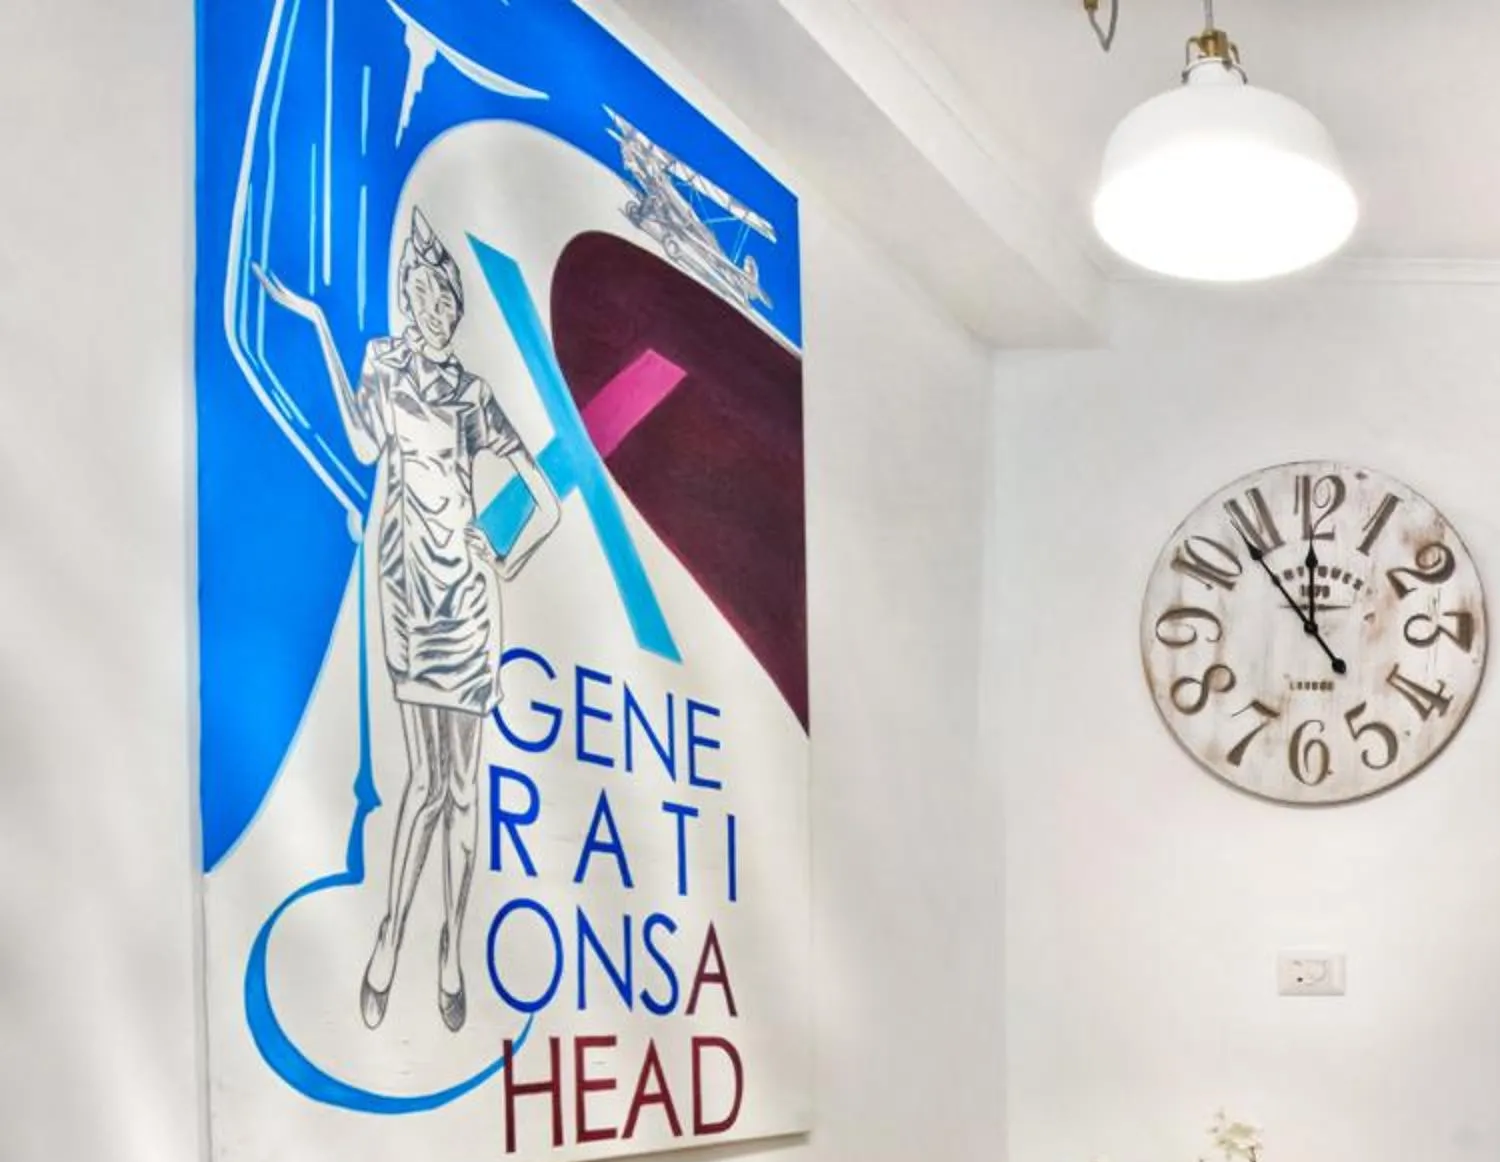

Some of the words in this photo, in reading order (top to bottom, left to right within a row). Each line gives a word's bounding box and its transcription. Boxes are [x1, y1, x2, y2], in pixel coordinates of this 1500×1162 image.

[1293, 474, 1346, 541] 12
[1356, 492, 1404, 557] 1
[1170, 535, 1243, 591] 10
[1385, 541, 1456, 601] 2
[1155, 606, 1223, 649] 9
[1403, 611, 1475, 654] 3
[490, 647, 722, 791] GENE
[1170, 663, 1236, 715] 8
[1385, 663, 1454, 722] 4
[1226, 699, 1281, 767] 7
[1288, 719, 1330, 786] 6
[1344, 701, 1399, 770] 5
[489, 764, 737, 902] RATI
[503, 1035, 744, 1154] HEAD
